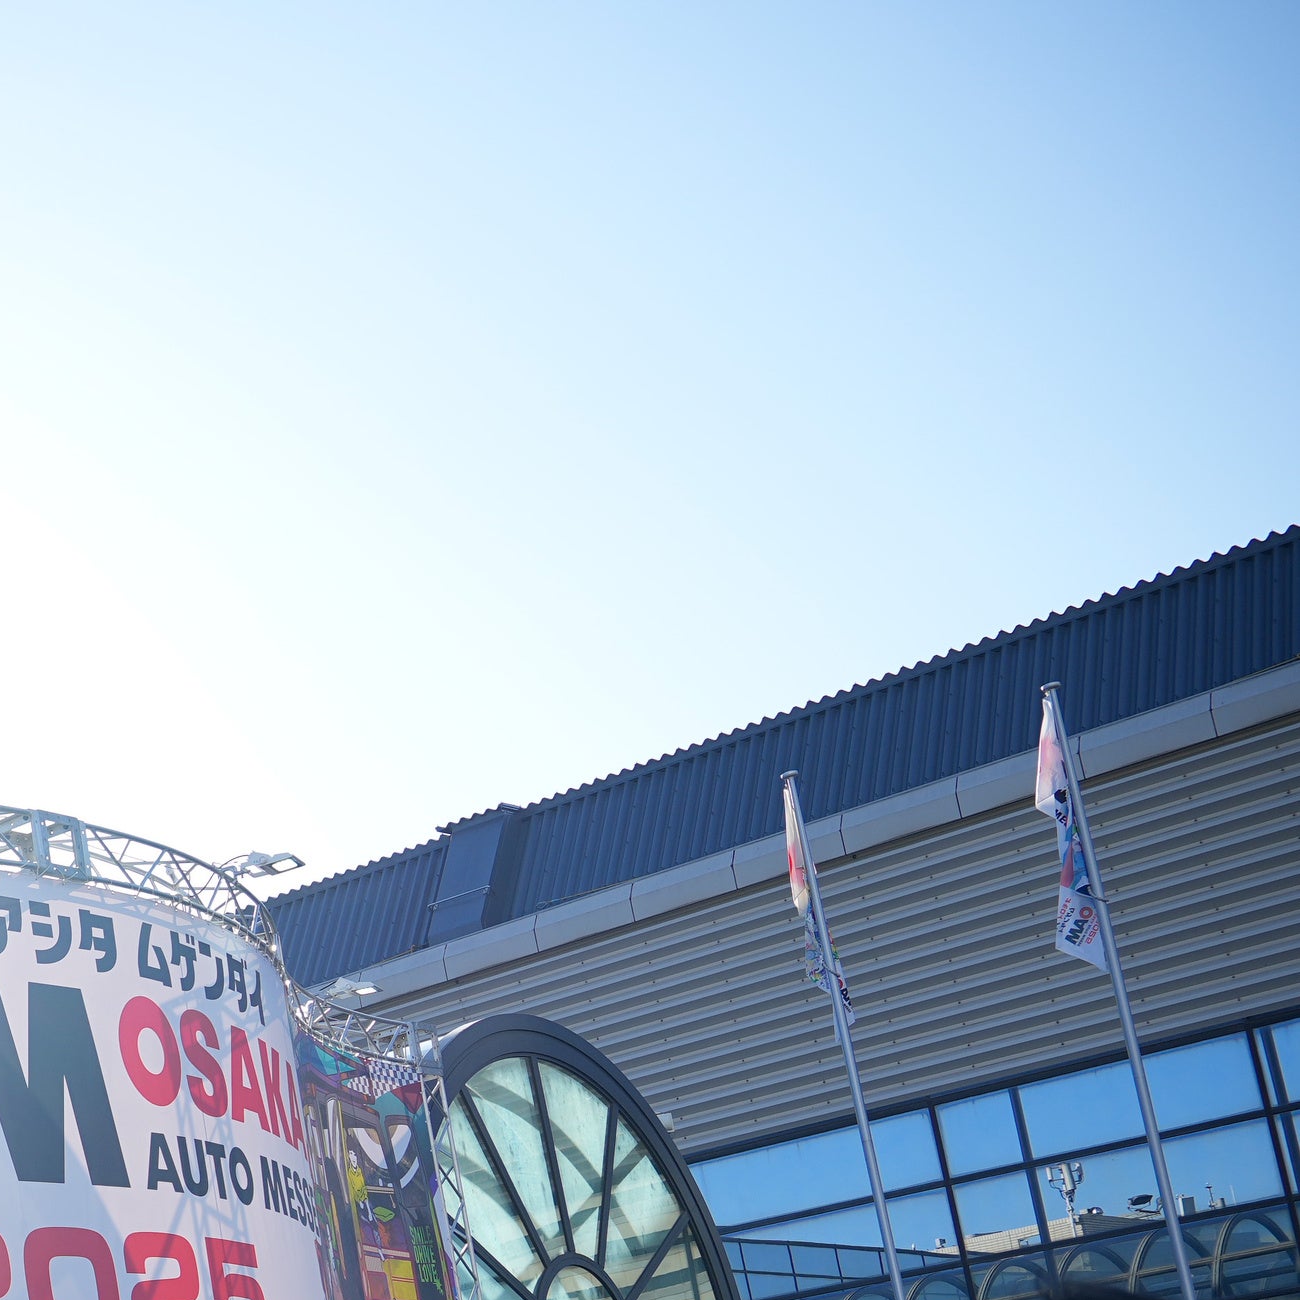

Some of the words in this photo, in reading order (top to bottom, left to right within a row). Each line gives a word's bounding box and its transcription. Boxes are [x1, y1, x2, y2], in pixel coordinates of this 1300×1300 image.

[138, 922, 266, 1027] ムゲンダイ
[118, 995, 309, 1164] OSAKA
[147, 1131, 254, 1206] AUTO
[408, 1225, 434, 1245] SMILE
[413, 1244, 436, 1264] DRIVE
[418, 1263, 438, 1283] LOVE
